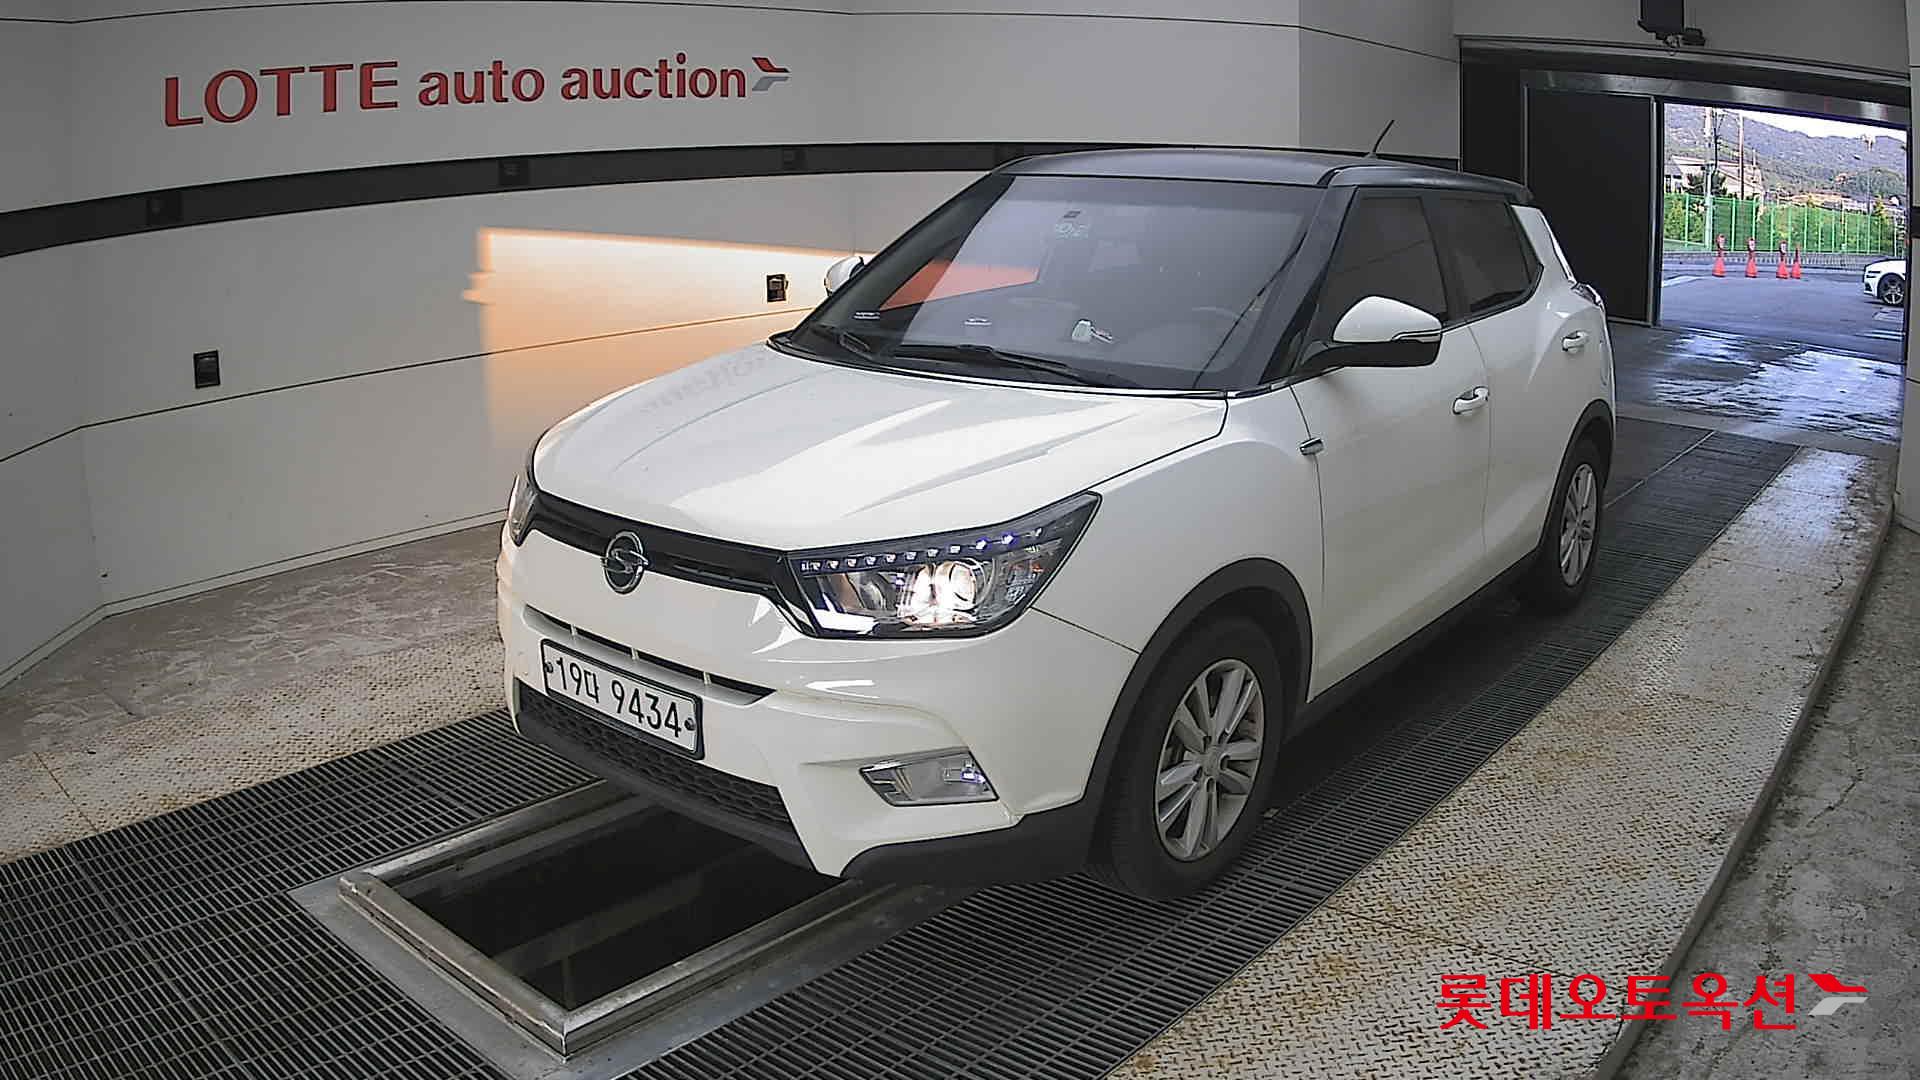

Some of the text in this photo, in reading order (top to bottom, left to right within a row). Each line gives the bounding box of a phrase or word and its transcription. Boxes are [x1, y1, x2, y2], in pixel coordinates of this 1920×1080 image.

[164, 52, 746, 127] LOTTE auto auction
[556, 657, 682, 738] 19다 9434
